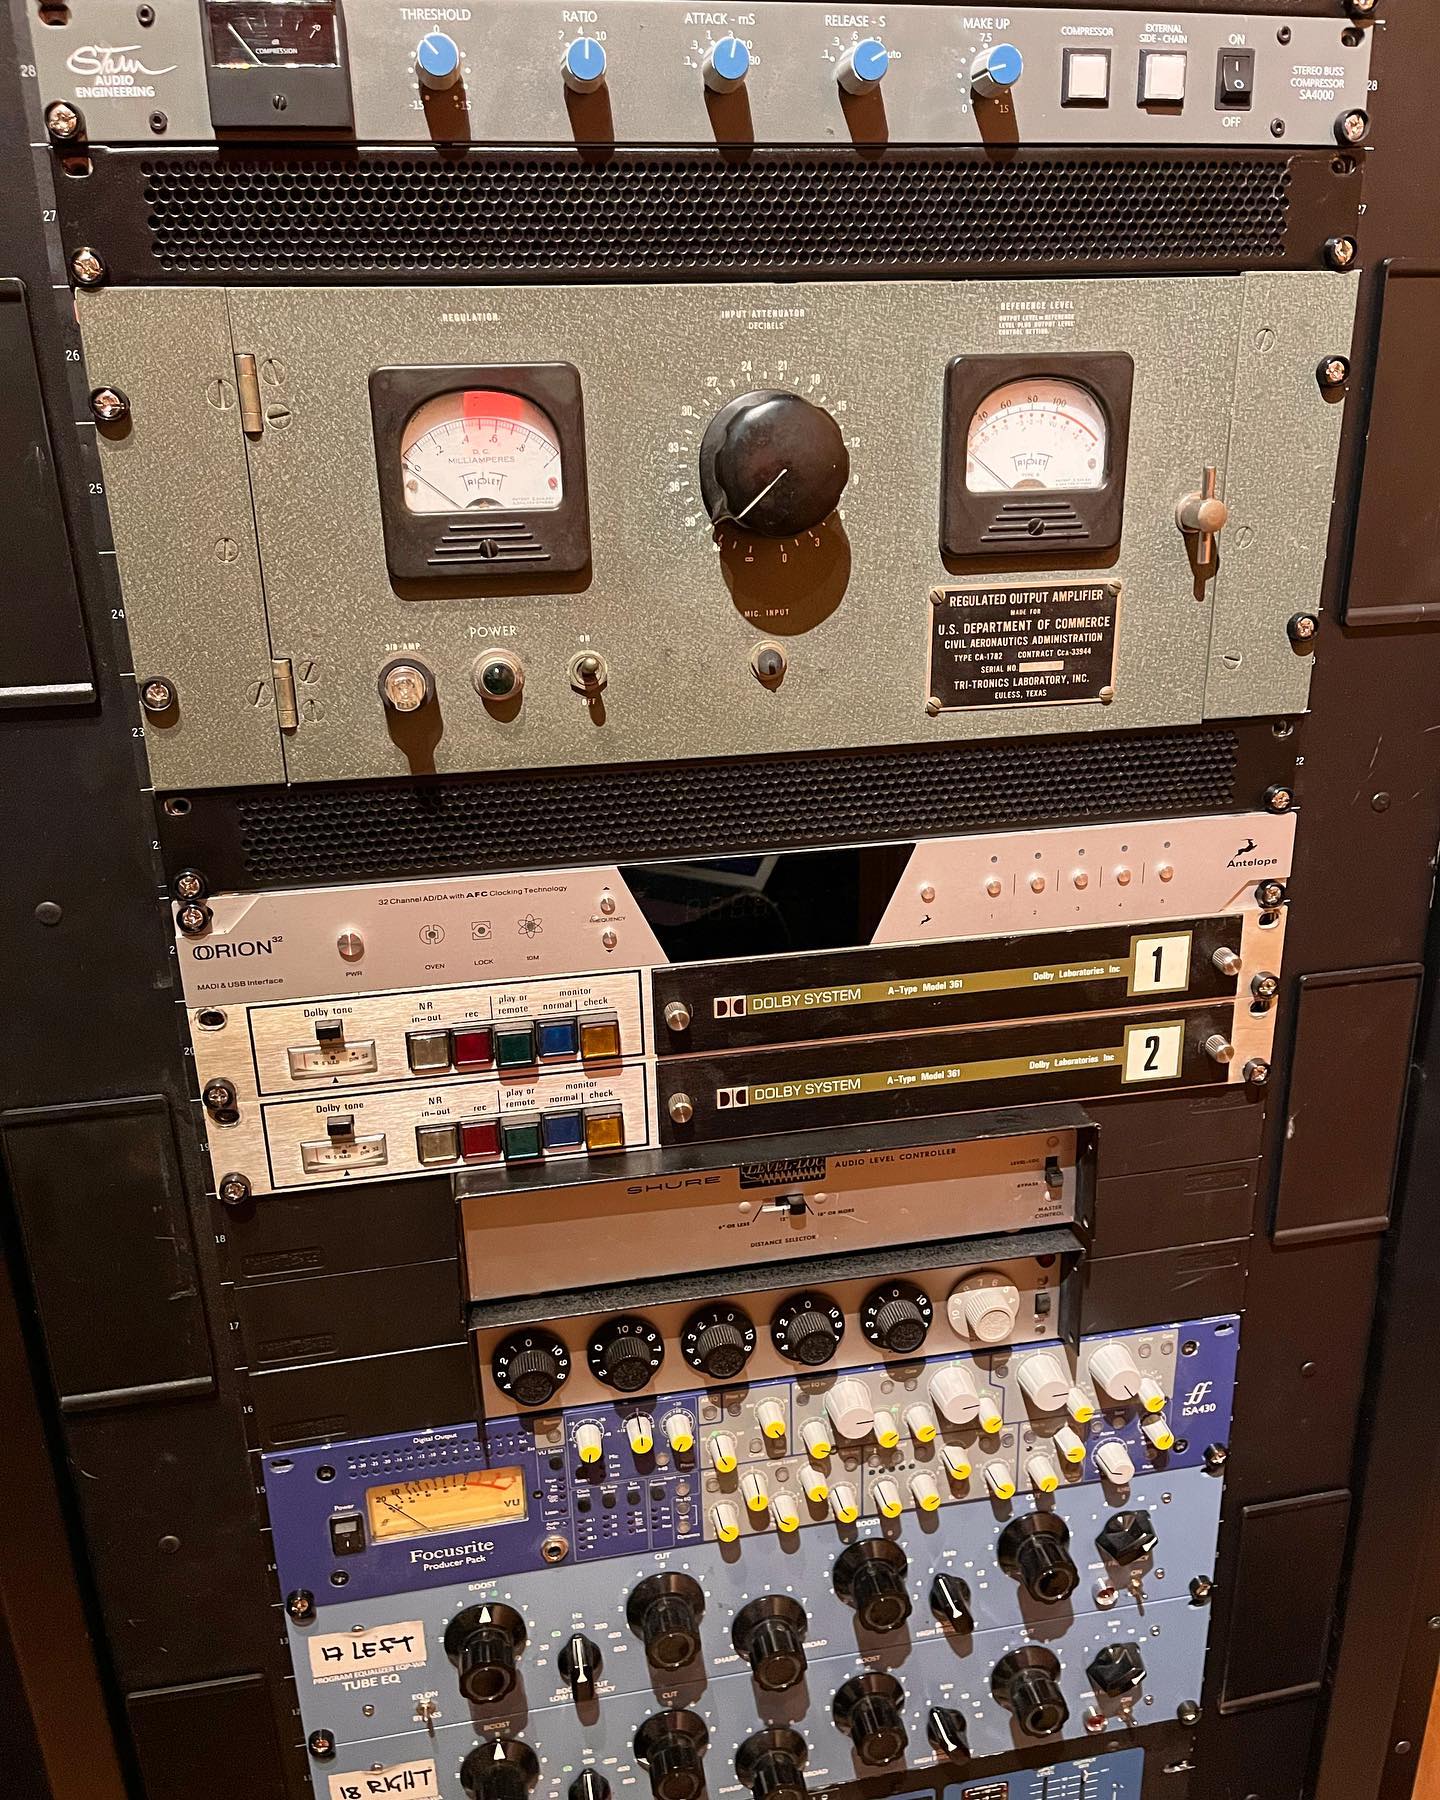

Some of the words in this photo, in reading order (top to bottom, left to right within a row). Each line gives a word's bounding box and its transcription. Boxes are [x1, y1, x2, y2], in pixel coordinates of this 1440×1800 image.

[400, 8, 471, 21] THRESHOLD
[562, 10, 598, 23] RATIO
[684, 13, 728, 25] ATTACK
[738, 13, 755, 25] mS
[825, 15, 869, 27] RELEASE
[879, 16, 886, 27] S
[963, 17, 993, 29] MAKE
[995, 18, 1010, 29] UP
[1061, 26, 1114, 37] COMPRESSOR
[1145, 23, 1183, 34] EXTERNAL
[1139, 33, 1157, 43] SIDE
[1163, 34, 1188, 44] CHAIN
[1229, 34, 1245, 45] ON
[255, 47, 298, 55] COMPRESSION
[20, 65, 36, 77] 28
[1292, 66, 1322, 76] STEREO
[1323, 66, 1345, 76] BUSS
[95, 75, 134, 87] AUDIO
[1290, 78, 1345, 89] COMPRESSOR
[75, 86, 155, 98] ENGINEERING
[1299, 90, 1335, 101] SA4000
[1222, 116, 1242, 128] OFF
[43, 210, 57, 223] 27
[1000, 301, 1047, 311] REFERENCE
[1049, 300, 1075, 310] LEVEL
[442, 312, 499, 322] REGULATION
[721, 310, 748, 319] INPUT
[751, 309, 805, 318] ATTENUATOR
[748, 322, 784, 330] DECIBELS
[65, 350, 80, 362] 26
[741, 361, 752, 371] 24
[778, 360, 788, 371] 21
[682, 405, 693, 416] 30
[851, 437, 861, 447] 12
[448, 456, 515, 465] MILLIAMPERES
[89, 483, 103, 495] 25
[949, 594, 1007, 607] REGULATED
[1009, 592, 1049, 605] OUTPUT
[1052, 589, 1104, 603] AMPLIFIER
[111, 609, 125, 620] 24
[744, 608, 763, 617] MIC.
[765, 607, 790, 617] INPUT
[470, 625, 518, 637] POWER
[938, 624, 959, 636] U.S.
[963, 619, 1033, 635] DEPARTMENT
[1037, 619, 1050, 630] OF
[1055, 616, 1111, 629] COMMERCE
[579, 634, 591, 643] ON
[944, 638, 967, 650] CIVIL
[970, 635, 1029, 648] AERONAUTICS
[1032, 632, 1103, 646] ADMINISTRATION
[954, 654, 973, 662] TYPE
[974, 652, 1003, 661] CA-1782
[1017, 649, 1053, 659] CONTRACT
[980, 665, 1004, 674] SERIAL
[1006, 664, 1019, 672] NO.
[954, 678, 1010, 690] TRI-TRONICS
[1012, 674, 1070, 687] LABORATORY,
[1072, 673, 1090, 684] INC.
[994, 690, 1024, 699] EULESS,
[1026, 689, 1047, 698] TEXAS
[131, 727, 145, 738] 23
[1226, 856, 1278, 868] Antelope
[378, 898, 389, 906] 32
[389, 896, 422, 905] Channel
[422, 894, 449, 903] AD/DA
[449, 892, 465, 900] with
[466, 890, 488, 899] AFC
[489, 887, 523, 897] Clocking
[524, 884, 568, 895] Technology
[424, 962, 445, 971] OVEN
[474, 959, 494, 967] LOCK
[1152, 946, 1163, 983] 1
[345, 970, 363, 978] PWR
[197, 982, 220, 991] MADI
[228, 980, 246, 988] USB
[247, 977, 284, 987] Interface
[753, 994, 801, 1010] DOLBY
[803, 988, 861, 1005] SYSTEM
[887, 985, 918, 996] A-Type
[922, 981, 947, 992] Model
[949, 979, 963, 989] 361
[1033, 970, 1055, 982] Dolby
[1058, 966, 1105, 978] Laboratories
[1109, 964, 1121, 974] Inc
[559, 987, 592, 997] monitor
[498, 995, 516, 1005] play
[543, 1001, 573, 1011] normal
[583, 997, 608, 1007] check
[419, 1002, 433, 1011] NR
[498, 1005, 529, 1015] remote
[304, 1008, 329, 1019] Dolby
[332, 1006, 353, 1016] tone
[465, 1010, 479, 1019] rec
[411, 1014, 442, 1024] in-out
[1143, 1035, 1160, 1072] 2
[755, 1084, 802, 1100] DOLBY
[805, 1078, 861, 1095] SYSTEM
[887, 1074, 916, 1085] A-Type
[921, 1071, 945, 1081] Model
[947, 1069, 961, 1078] 361
[1029, 1059, 1050, 1070] Dolby
[1054, 1055, 1099, 1067] Laboratories
[1103, 1053, 1115, 1062] Inc
[565, 1081, 598, 1090] monitor
[506, 1088, 523, 1099] play
[549, 1093, 578, 1104] normal
[589, 1089, 614, 1099] check
[428, 1096, 442, 1105] NR
[506, 1098, 535, 1108] remote
[316, 1103, 341, 1114] Dolby
[344, 1102, 364, 1111] tone
[421, 1108, 450, 1117] in-out
[473, 1104, 487, 1112] rec
[834, 1158, 865, 1168] AUDIO
[869, 1154, 895, 1164] LEVEL
[899, 1148, 957, 1161] CONTROLLER
[626, 1175, 721, 1195] SHURE
[1038, 1204, 1062, 1212] MASTER
[1034, 1211, 1064, 1219] CONTROL
[214, 1234, 226, 1243] 18
[750, 1239, 782, 1248] DISTANCE
[785, 1234, 817, 1243] SELECTOR
[617, 1325, 629, 1334] 10
[1182, 1403, 1217, 1417] ISA430
[413, 1436, 433, 1445] Digital
[434, 1432, 458, 1442] Output
[334, 1503, 354, 1511] Power
[504, 1498, 520, 1507] VU
[409, 1539, 494, 1564] Focusrite
[654, 1551, 671, 1561] CUT
[423, 1557, 464, 1572] Producer
[465, 1554, 486, 1565] Pack
[468, 1580, 497, 1591] BOOST
[352, 1635, 414, 1660] LEFT
[714, 1656, 740, 1665] SHARP
[313, 1672, 353, 1684] PROGRAM
[354, 1665, 395, 1678] EQUALIZER
[342, 1675, 379, 1691] TUBE
[381, 1673, 401, 1686] EQ
[412, 1692, 424, 1701] EQ
[425, 1690, 438, 1698] ON
[662, 1690, 678, 1699] CUT
[484, 1721, 510, 1731] BOOST
[340, 1786, 361, 1800] 18
[366, 1768, 432, 1794] RIGHT
